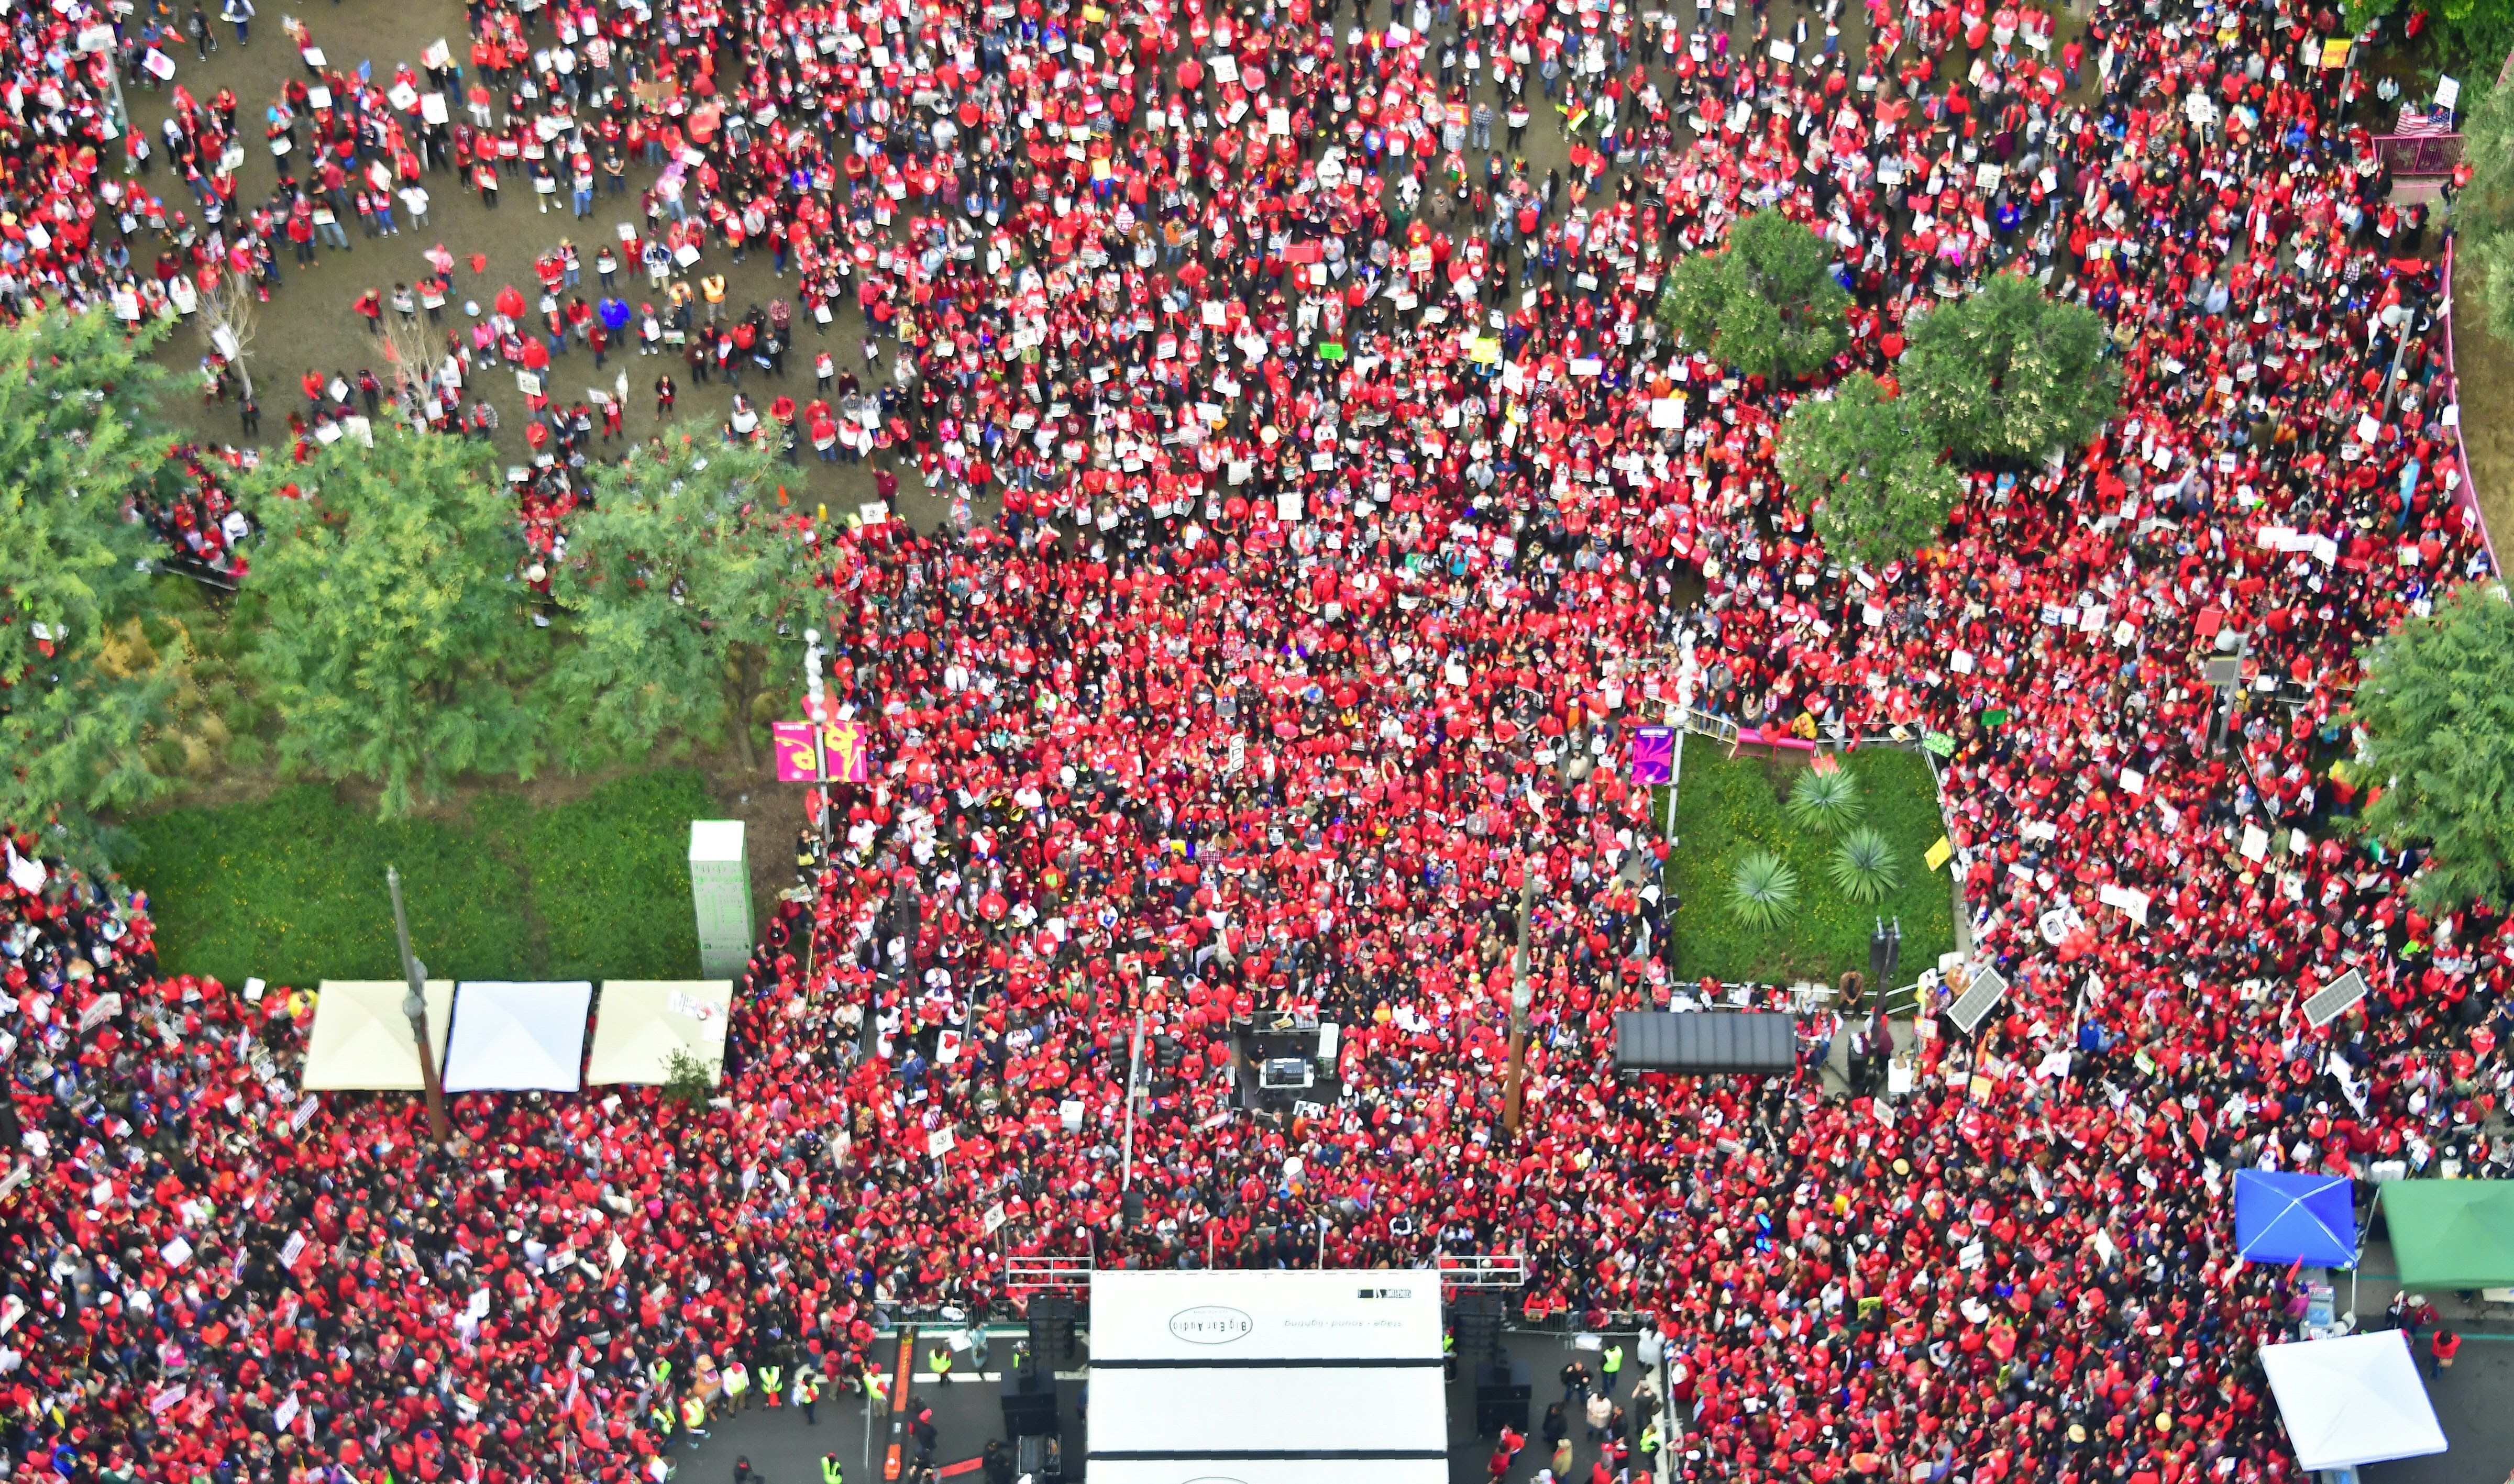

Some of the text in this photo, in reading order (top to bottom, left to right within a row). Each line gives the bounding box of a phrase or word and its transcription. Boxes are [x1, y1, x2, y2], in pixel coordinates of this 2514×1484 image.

[1173, 1318, 1247, 1332] Big Ear Audio
[1284, 1319, 1403, 1327] stage sound lighting
